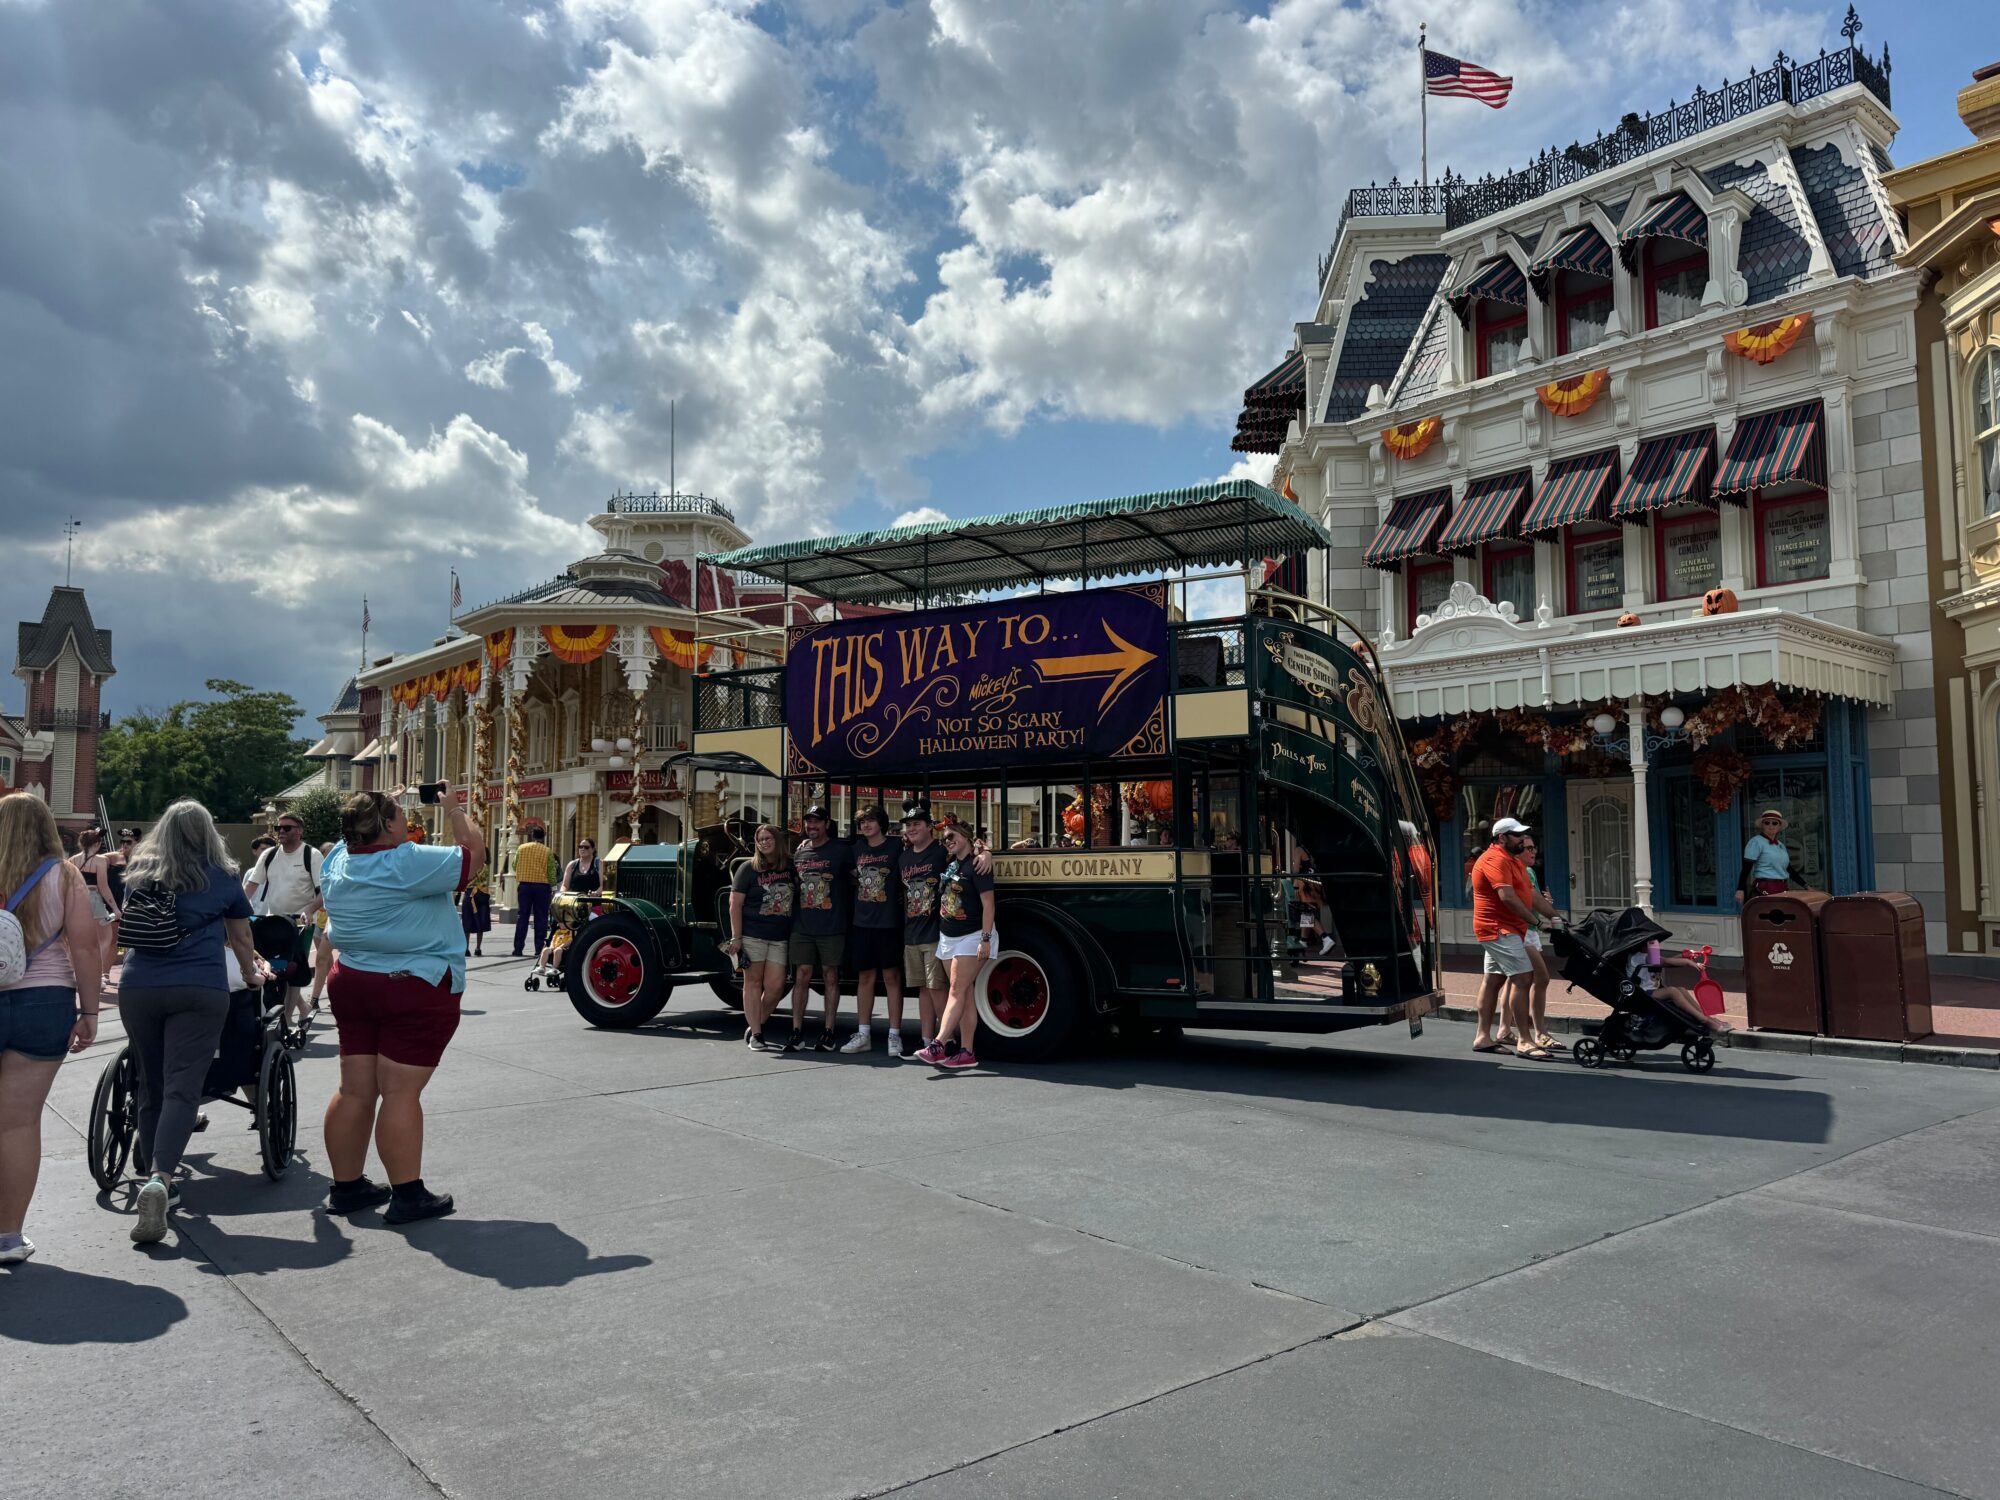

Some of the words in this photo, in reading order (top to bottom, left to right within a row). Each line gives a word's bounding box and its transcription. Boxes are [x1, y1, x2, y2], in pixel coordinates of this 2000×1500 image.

[1679, 542, 1709, 555] COMPANY
[1674, 563, 1715, 575] CONTRACTOR
[1680, 557, 1708, 567] GENERAL
[1287, 657, 1312, 677] CENTER
[811, 629, 884, 748] THIS
[896, 620, 988, 688] WAY
[936, 717, 973, 736] NOT
[978, 715, 1003, 733] SO
[1007, 711, 1063, 731] SCARY
[919, 734, 1018, 756] HALLOWEEN
[1023, 727, 1086, 750] PARTY!
[1271, 742, 1298, 760] DOLLS
[1299, 756, 1306, 765] &
[1306, 754, 1327, 774] TOYS
[1061, 858, 1143, 877] COMPANY
